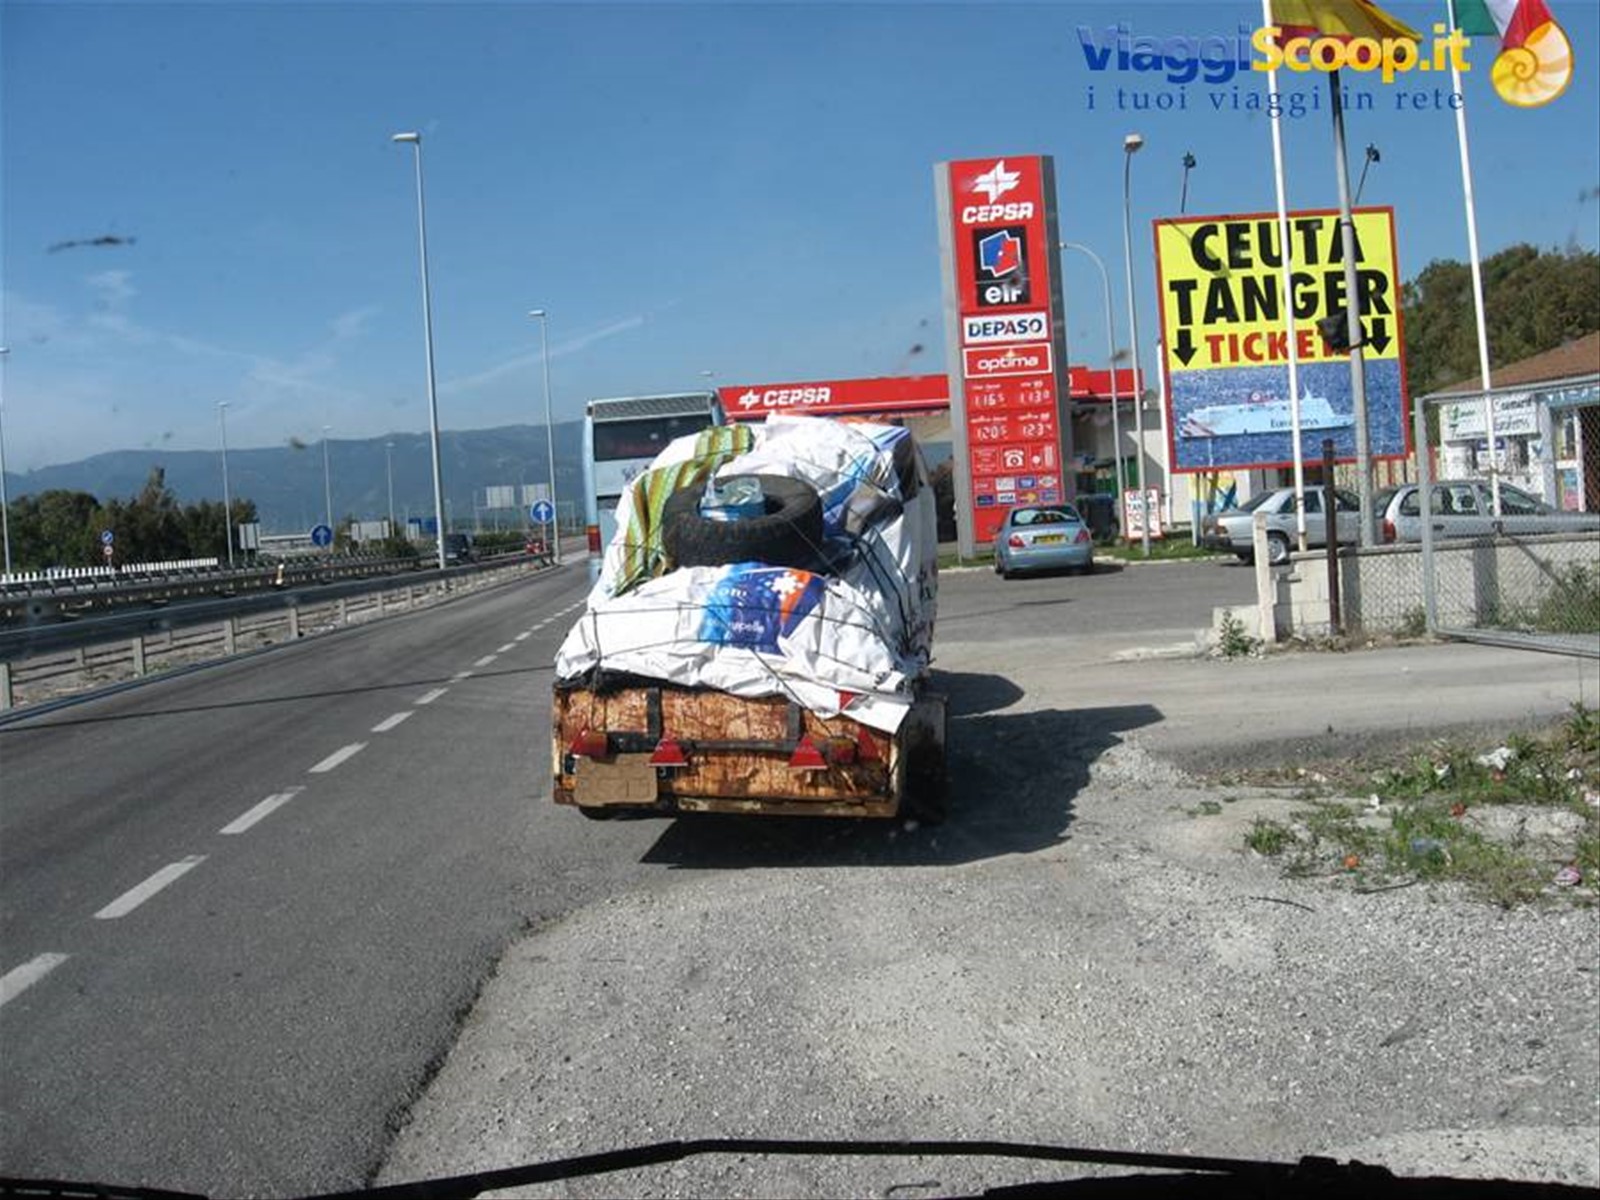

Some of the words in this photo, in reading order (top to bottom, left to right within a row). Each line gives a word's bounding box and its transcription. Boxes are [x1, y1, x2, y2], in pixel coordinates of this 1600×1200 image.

[962, 201, 1034, 224] CEPSA
[1191, 217, 1365, 272] CEUTA
[1169, 269, 1392, 326] TANGER
[968, 317, 1043, 338] DEPASO
[977, 355, 1039, 373] optima
[763, 387, 831, 407] CEPSA
